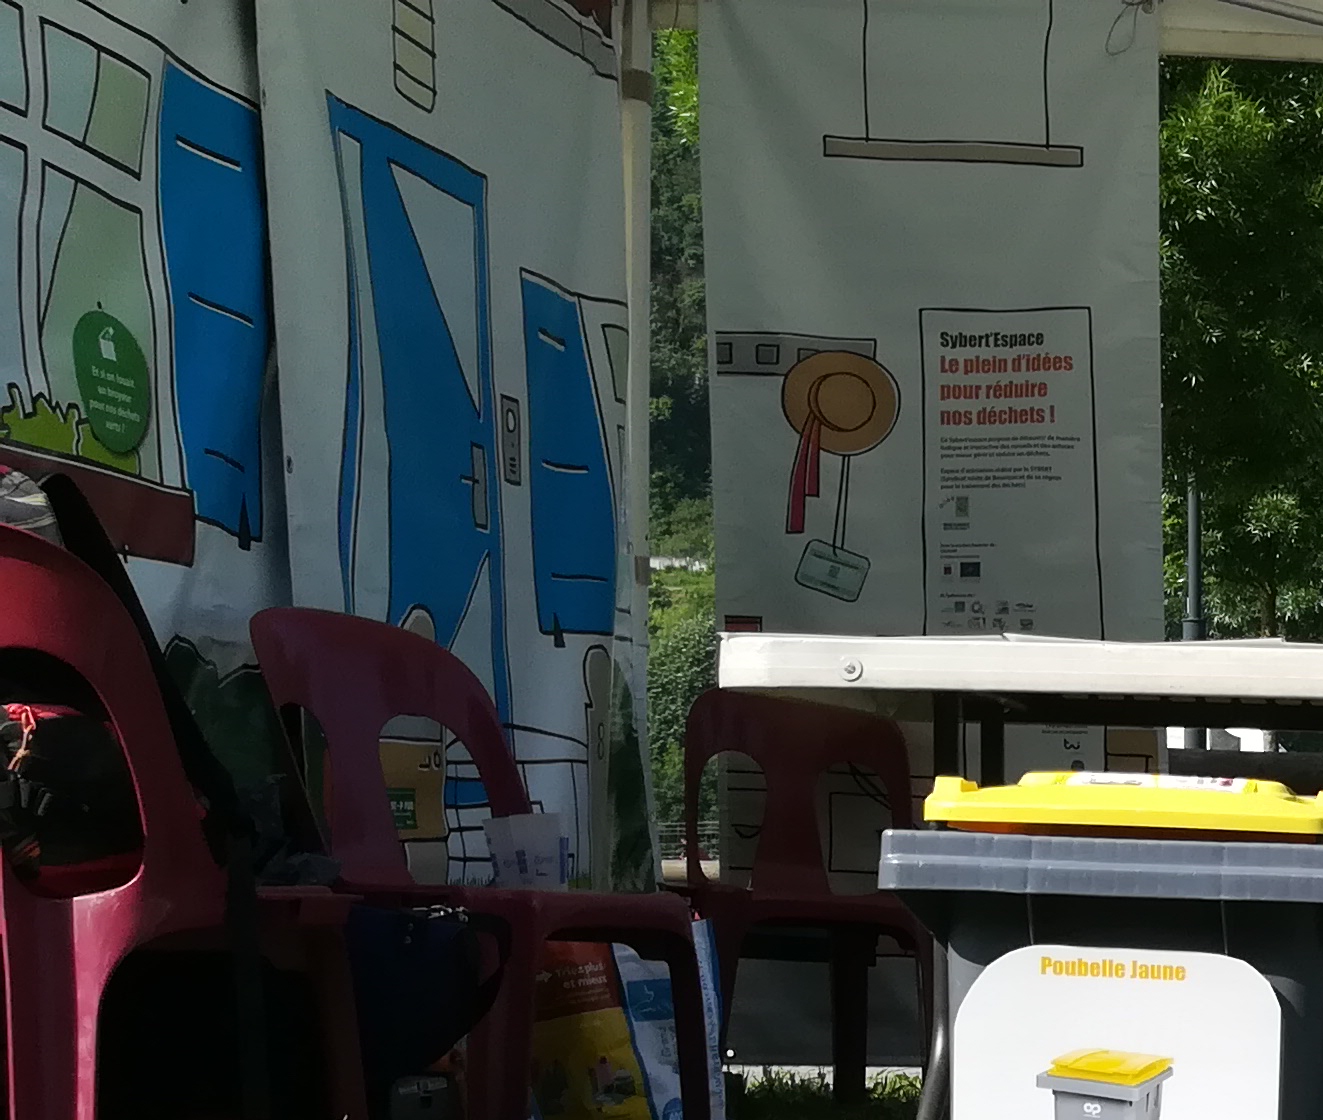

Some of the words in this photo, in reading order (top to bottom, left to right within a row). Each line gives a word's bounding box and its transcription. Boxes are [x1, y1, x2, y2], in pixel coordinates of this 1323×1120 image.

[940, 331, 1044, 349] Sybert'Espace
[940, 355, 960, 374] Le
[963, 355, 1008, 375] plein
[1012, 352, 1073, 373] d'idées
[940, 384, 982, 401] pour
[986, 380, 1048, 400] réduire
[940, 410, 973, 426] nos
[976, 406, 1046, 425] déchets
[1041, 957, 1126, 978] Poubelle
[1130, 960, 1187, 981] Jaune
